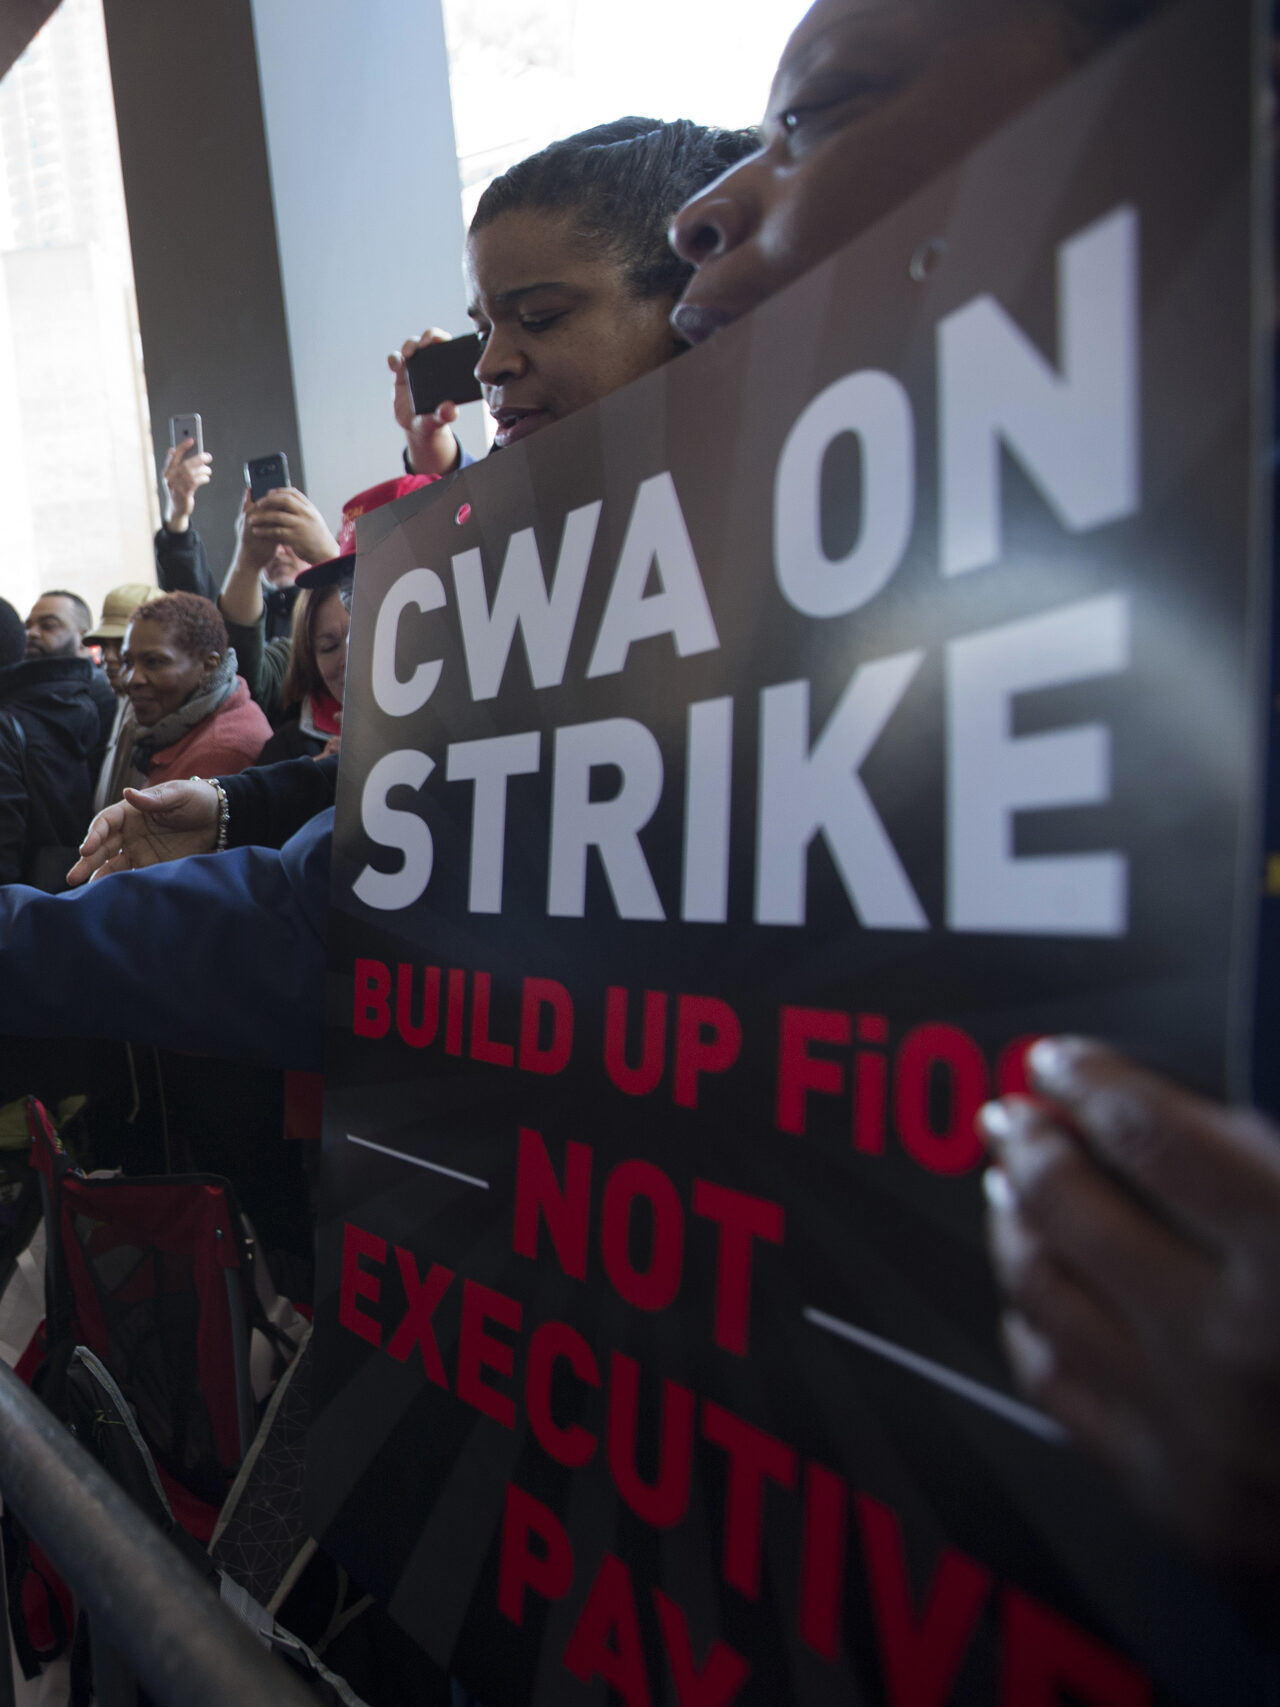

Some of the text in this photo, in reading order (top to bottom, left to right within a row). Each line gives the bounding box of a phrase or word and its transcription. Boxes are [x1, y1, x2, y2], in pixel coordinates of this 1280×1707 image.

[371, 206, 1140, 717] CWA ON
[351, 592, 1130, 938] STRIKE
[353, 958, 573, 1075] BUILD
[605, 986, 742, 1109] UP
[514, 1127, 784, 1357] NOT
